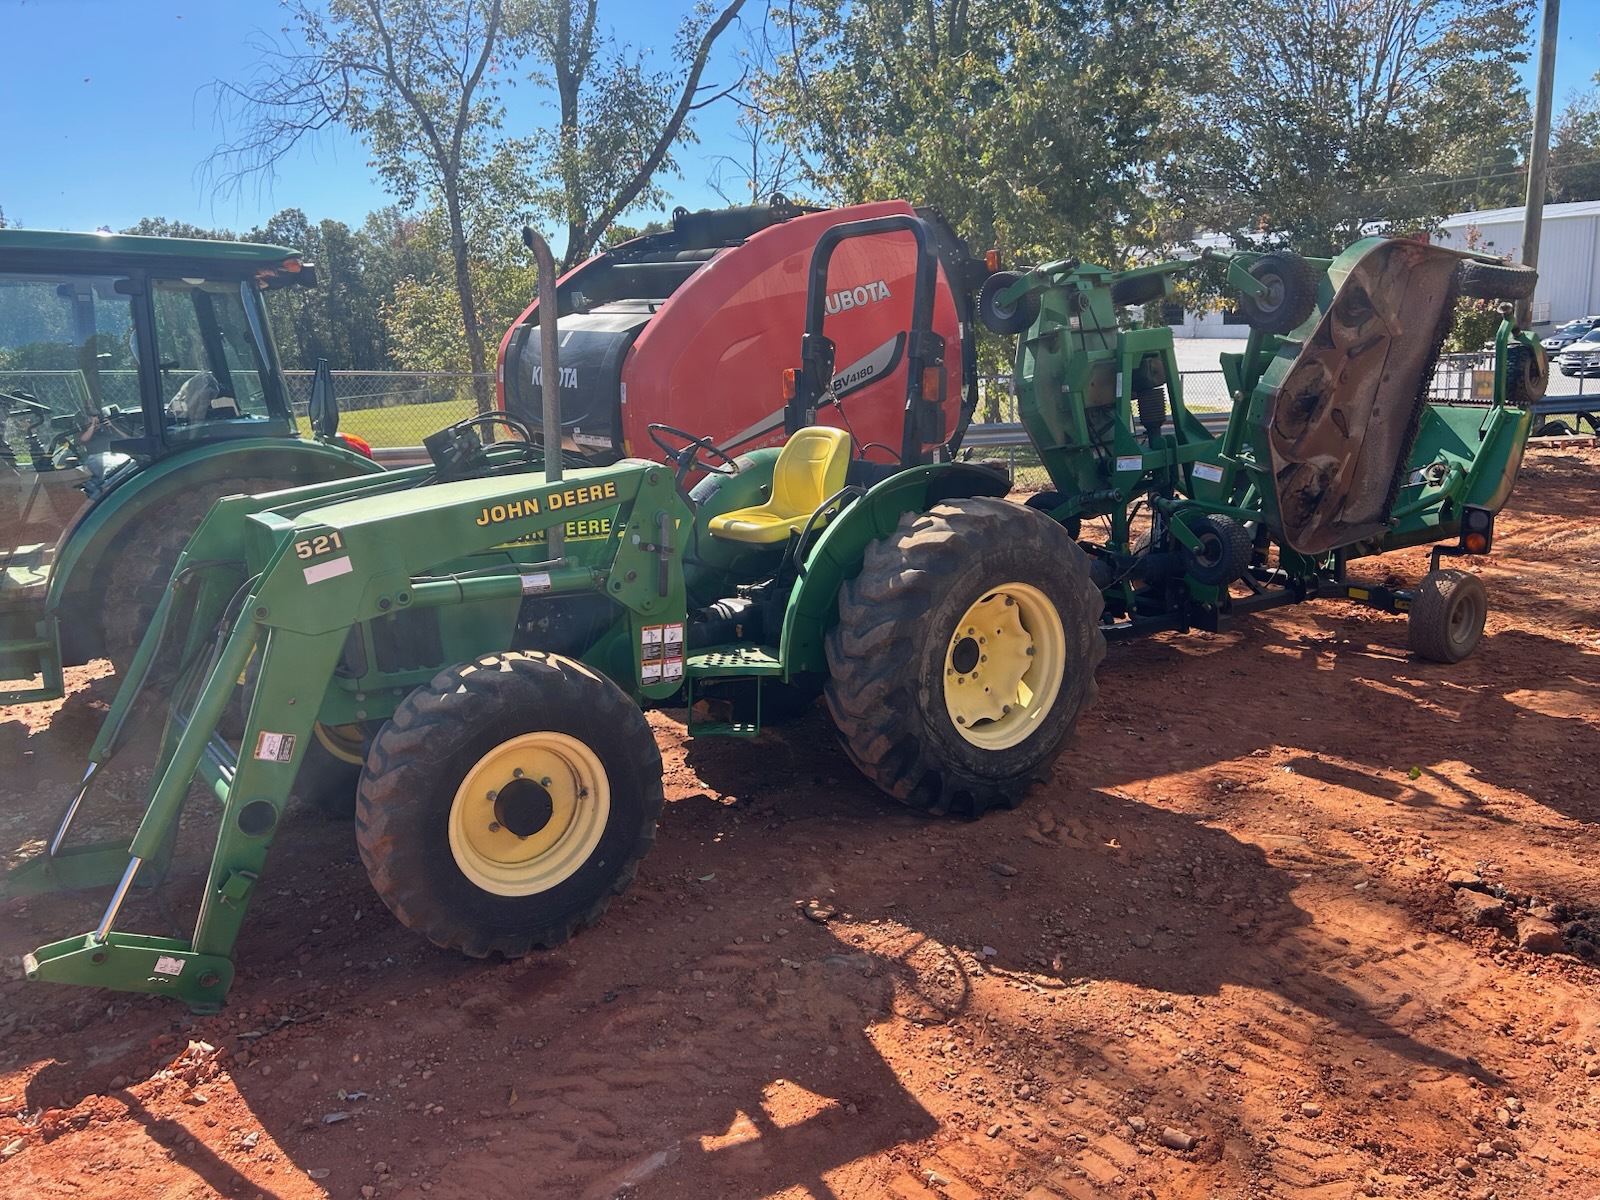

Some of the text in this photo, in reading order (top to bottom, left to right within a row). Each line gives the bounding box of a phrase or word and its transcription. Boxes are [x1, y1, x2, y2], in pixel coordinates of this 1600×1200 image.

[824, 280, 891, 316] UBOTA
[532, 366, 577, 388] KOTA
[833, 365, 874, 391] BV4180
[476, 482, 616, 527] JOHN DEERE
[565, 518, 610, 536] EERE
[295, 531, 342, 559] 521
